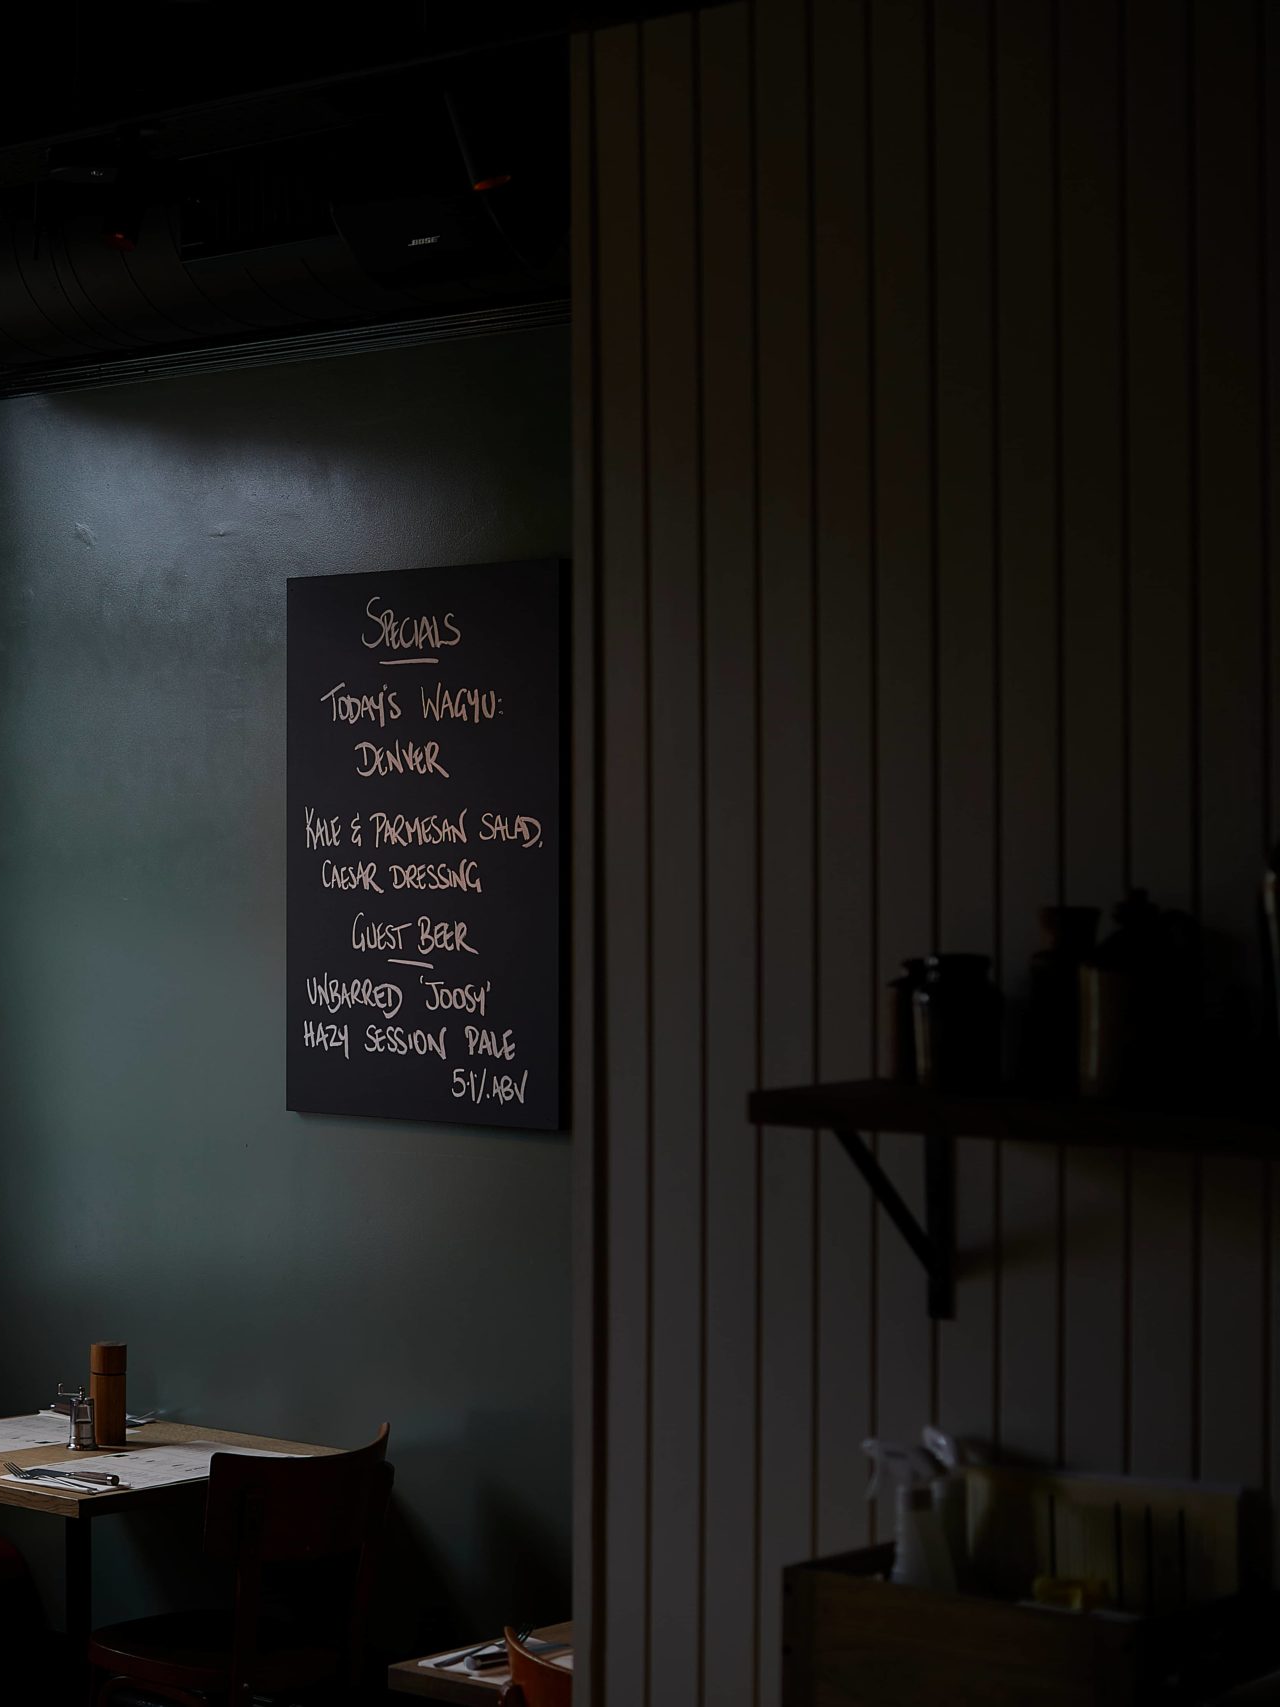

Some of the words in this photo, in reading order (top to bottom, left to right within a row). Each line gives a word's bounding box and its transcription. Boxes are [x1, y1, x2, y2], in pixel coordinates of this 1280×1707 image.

[361, 596, 461, 650] SPECIALS
[320, 681, 402, 728] TODAY'S
[420, 681, 504, 724] WAGYU:
[354, 738, 450, 779] DENVER
[304, 806, 342, 851] KALE
[350, 811, 362, 847] &
[368, 807, 468, 849] PARMESAN
[478, 812, 543, 849] SALAD,
[321, 859, 385, 894] CAESAR
[388, 858, 483, 894] DRESSING
[351, 911, 413, 953] GUEST
[417, 915, 480, 955] BEER
[306, 971, 403, 1020] UNBARRED
[303, 1019, 350, 1060] HAZY
[363, 1024, 447, 1061] SESSION
[464, 1025, 516, 1061] PALE
